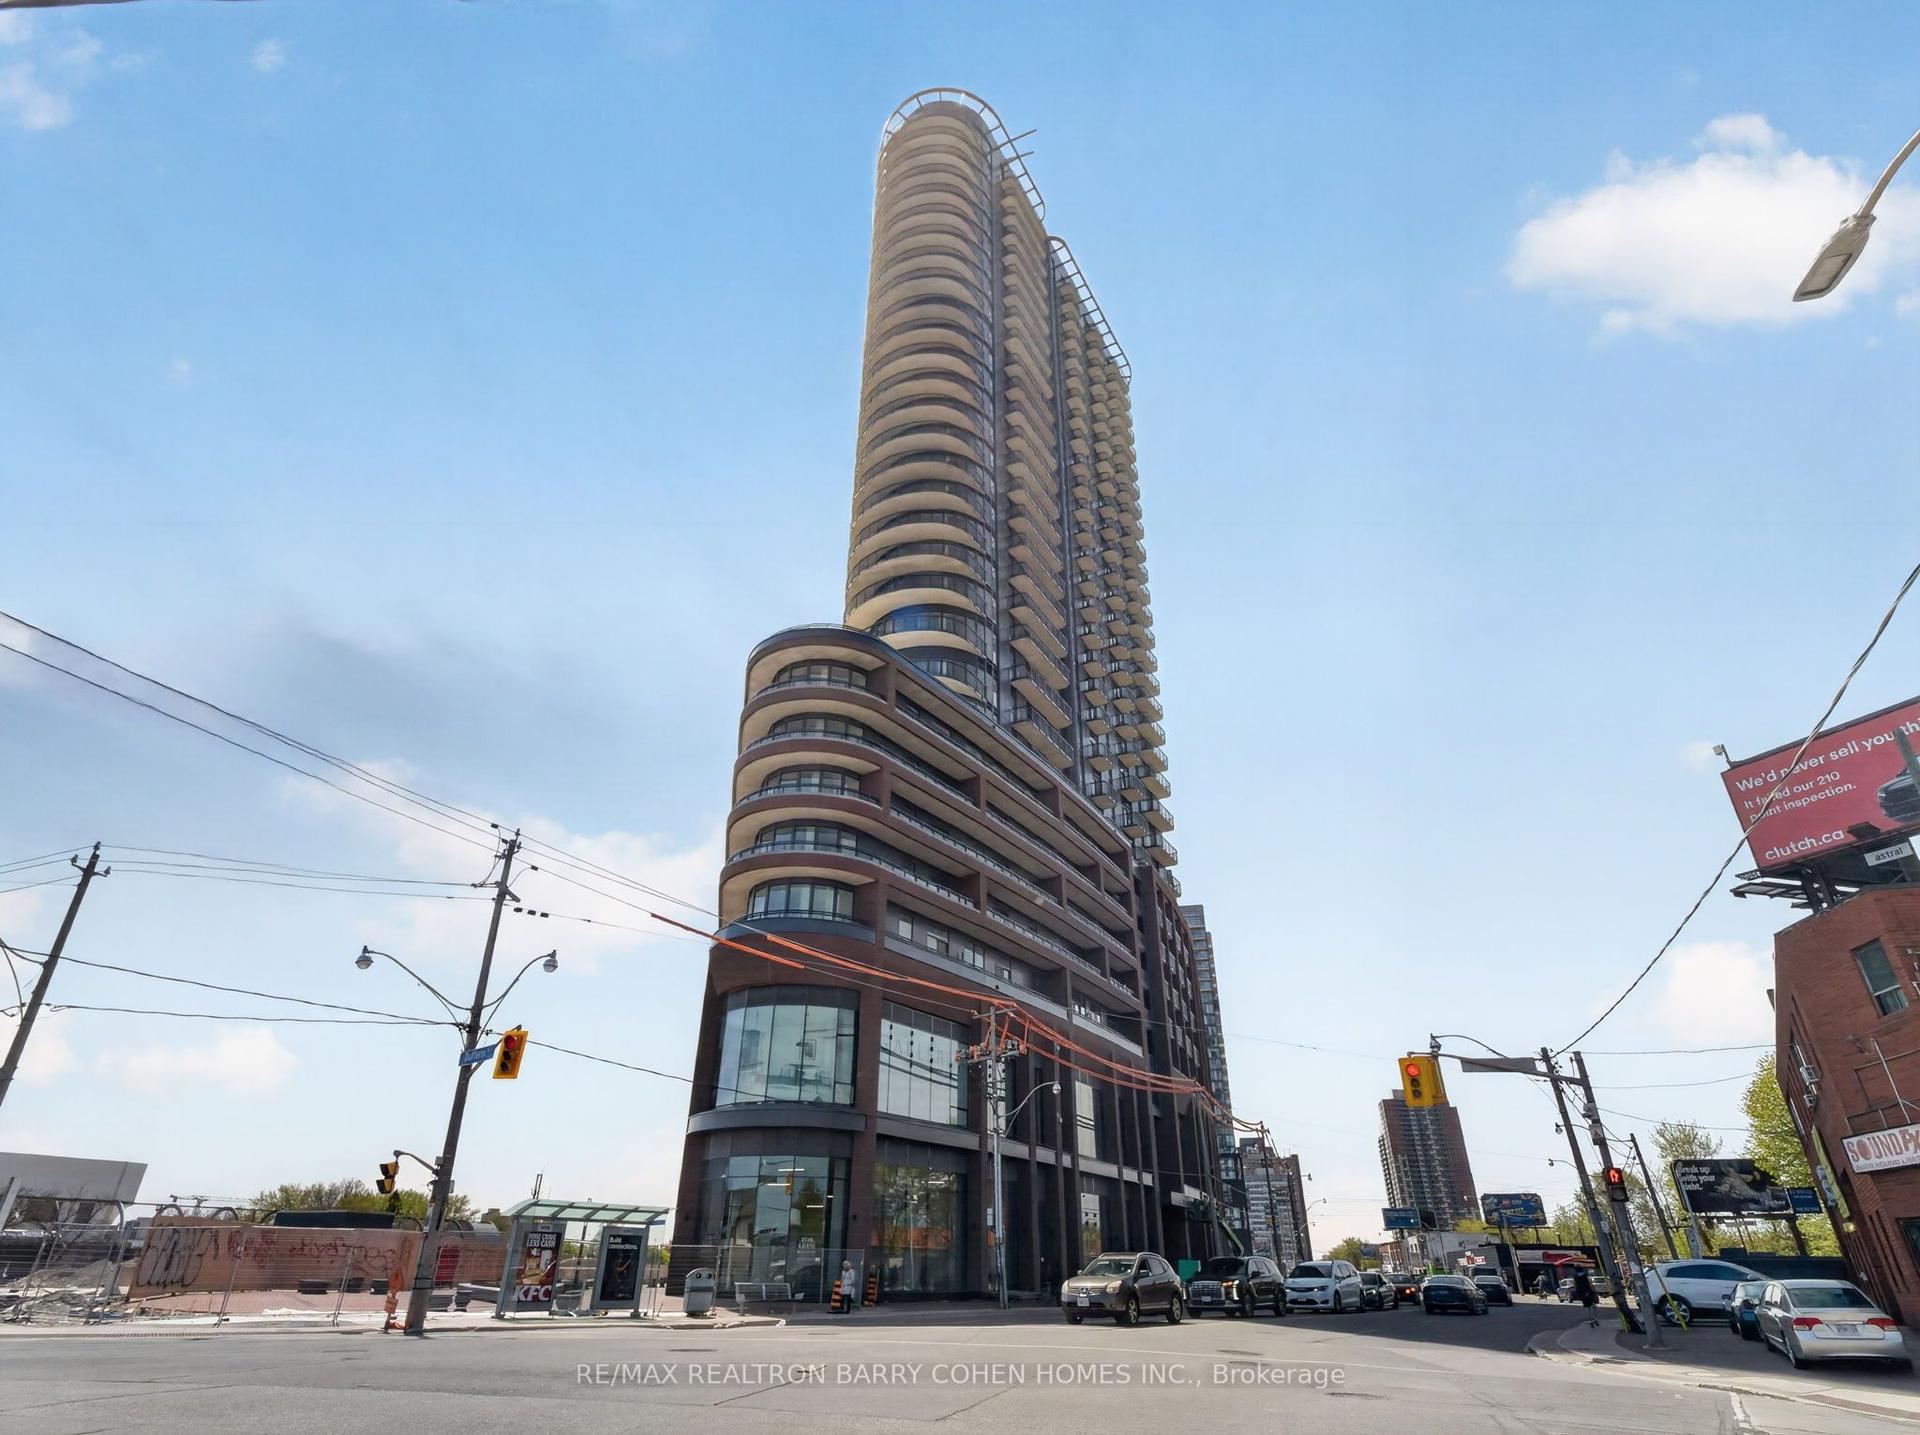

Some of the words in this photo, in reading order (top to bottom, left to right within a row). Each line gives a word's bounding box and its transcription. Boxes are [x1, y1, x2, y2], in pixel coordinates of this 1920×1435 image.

[1736, 769, 1777, 791] We'd
[1829, 740, 1859, 760] sell
[1861, 731, 1895, 751] you
[1743, 800, 1754, 809] It
[1793, 780, 1815, 793] our
[1816, 771, 1840, 786] 210
[1783, 783, 1857, 810] inspection.
[1765, 830, 1845, 860] clutch.ca
[1875, 847, 1904, 861] astral
[1846, 1132, 1904, 1162] SOUND
[1697, 1174, 1715, 1184] your
[513, 1285, 552, 1301] KFC
